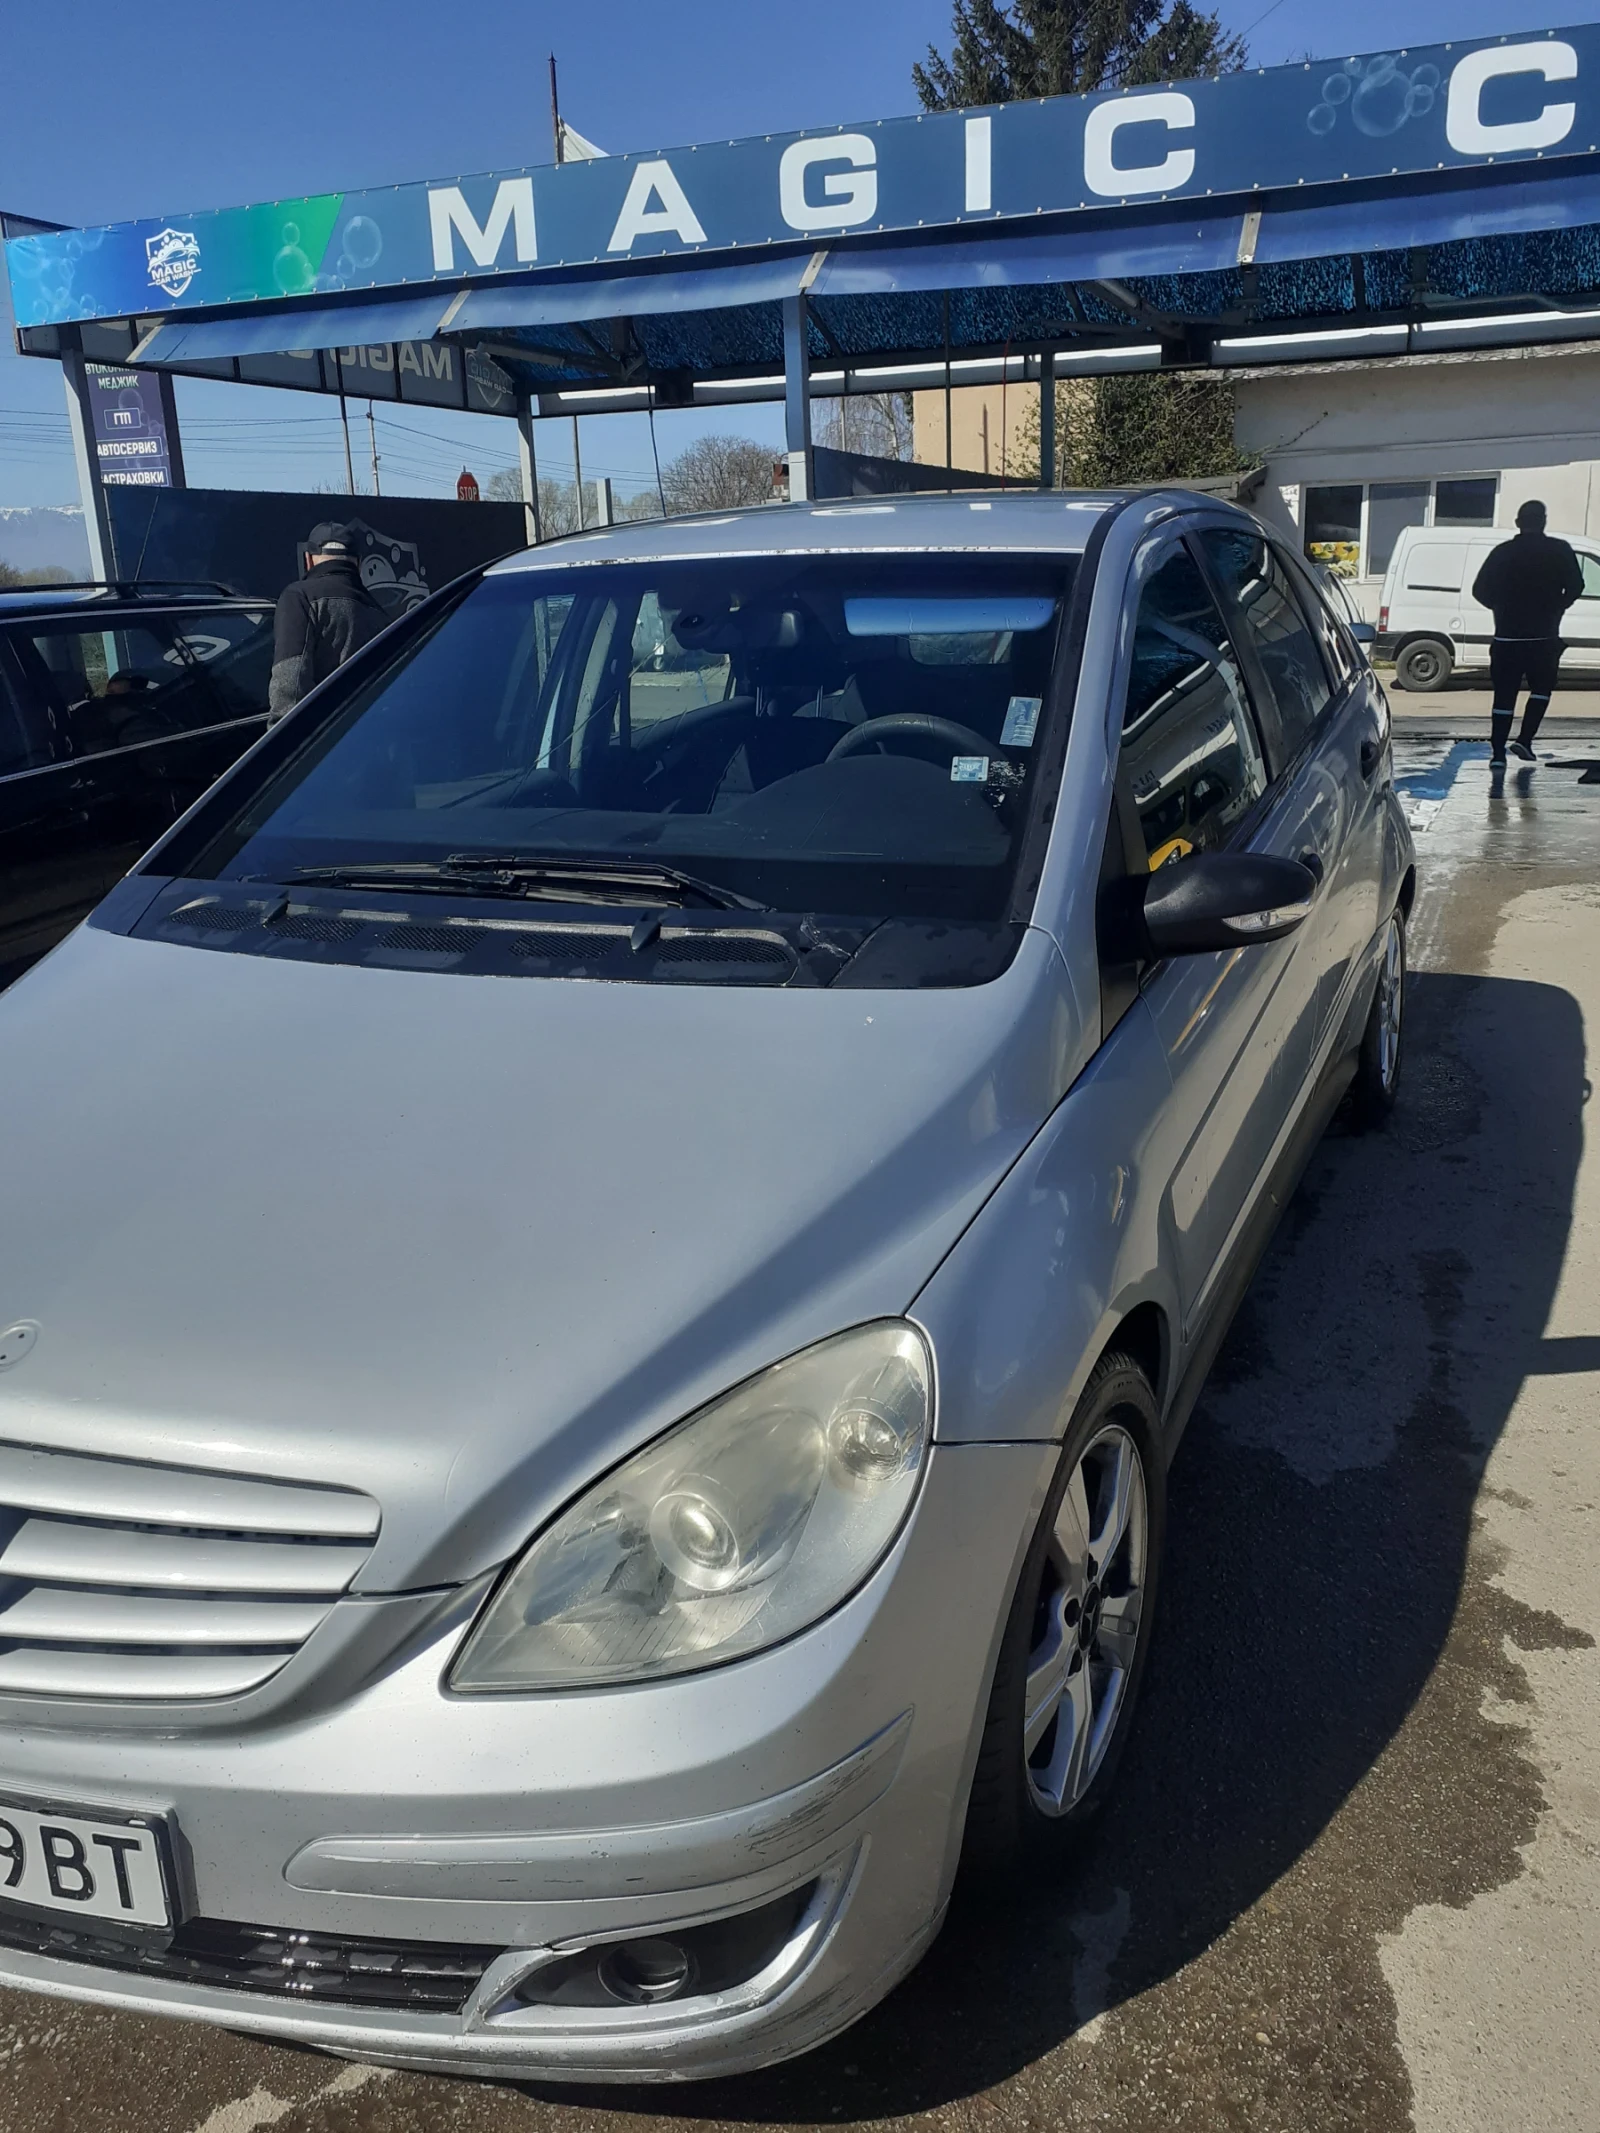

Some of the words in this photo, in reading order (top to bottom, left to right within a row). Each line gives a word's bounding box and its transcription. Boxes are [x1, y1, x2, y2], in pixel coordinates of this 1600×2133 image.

[428, 92, 1196, 272] MAGIC
[1446, 40, 1578, 155] C
[151, 258, 197, 281] MAGIC
[155, 276, 171, 286] CAR
[172, 269, 194, 281] WASH
[98, 375, 139, 390] МЕДЖИК
[113, 412, 132, 425] ГТП
[97, 441, 158, 456] АВТОСЕРВИЗ
[101, 471, 165, 485] АСТРАХОВКИ
[459, 486, 478, 500] STOP
